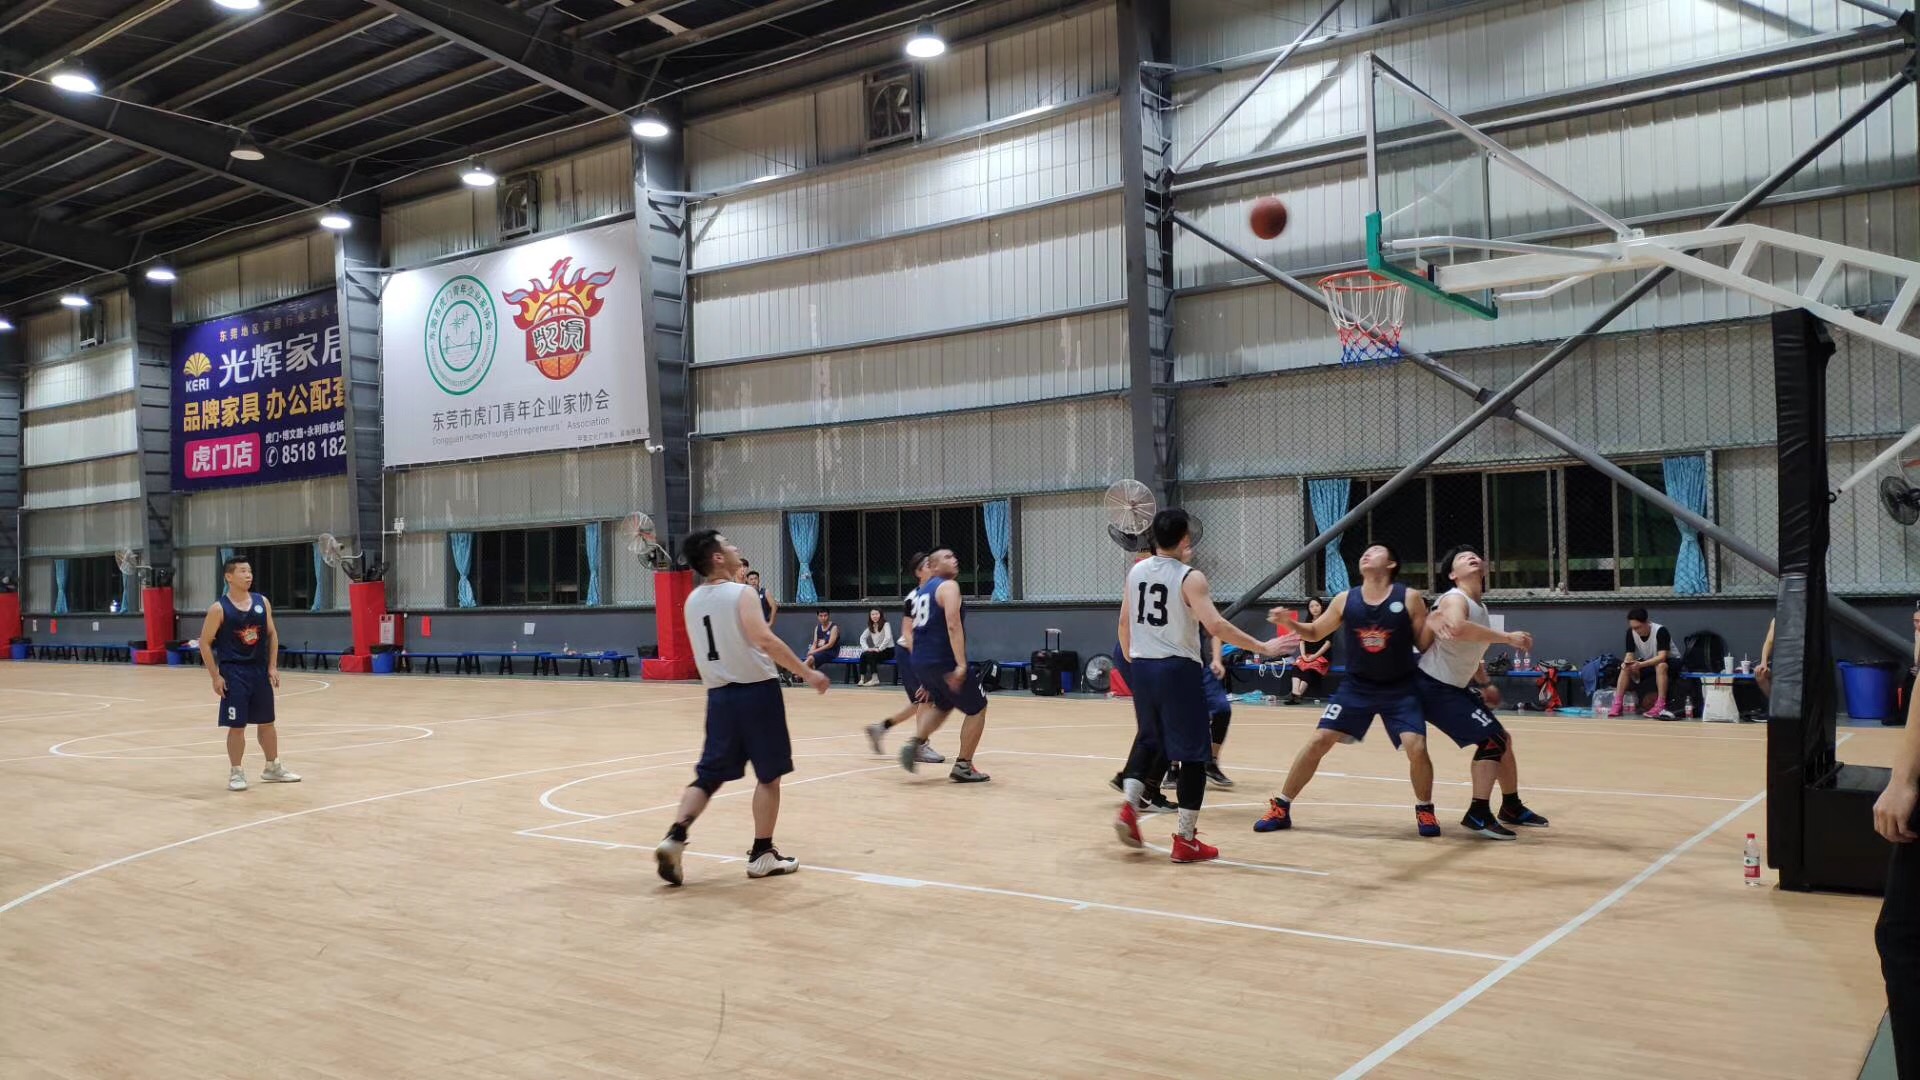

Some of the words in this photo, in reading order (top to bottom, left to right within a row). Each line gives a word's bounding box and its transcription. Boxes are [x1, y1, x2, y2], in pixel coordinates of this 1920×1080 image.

[219, 325, 342, 388] 光辉家居
[183, 391, 261, 432] 品牌家具
[266, 376, 345, 420] 办公配套
[185, 377, 210, 393] KERI
[432, 388, 610, 432] 东莞市虎门青年企业家协会
[191, 441, 253, 472] 虎门店
[281, 441, 316, 464] 8518
[1137, 582, 1168, 626] 13
[703, 615, 720, 661] 1
[228, 706, 236, 720] 9
